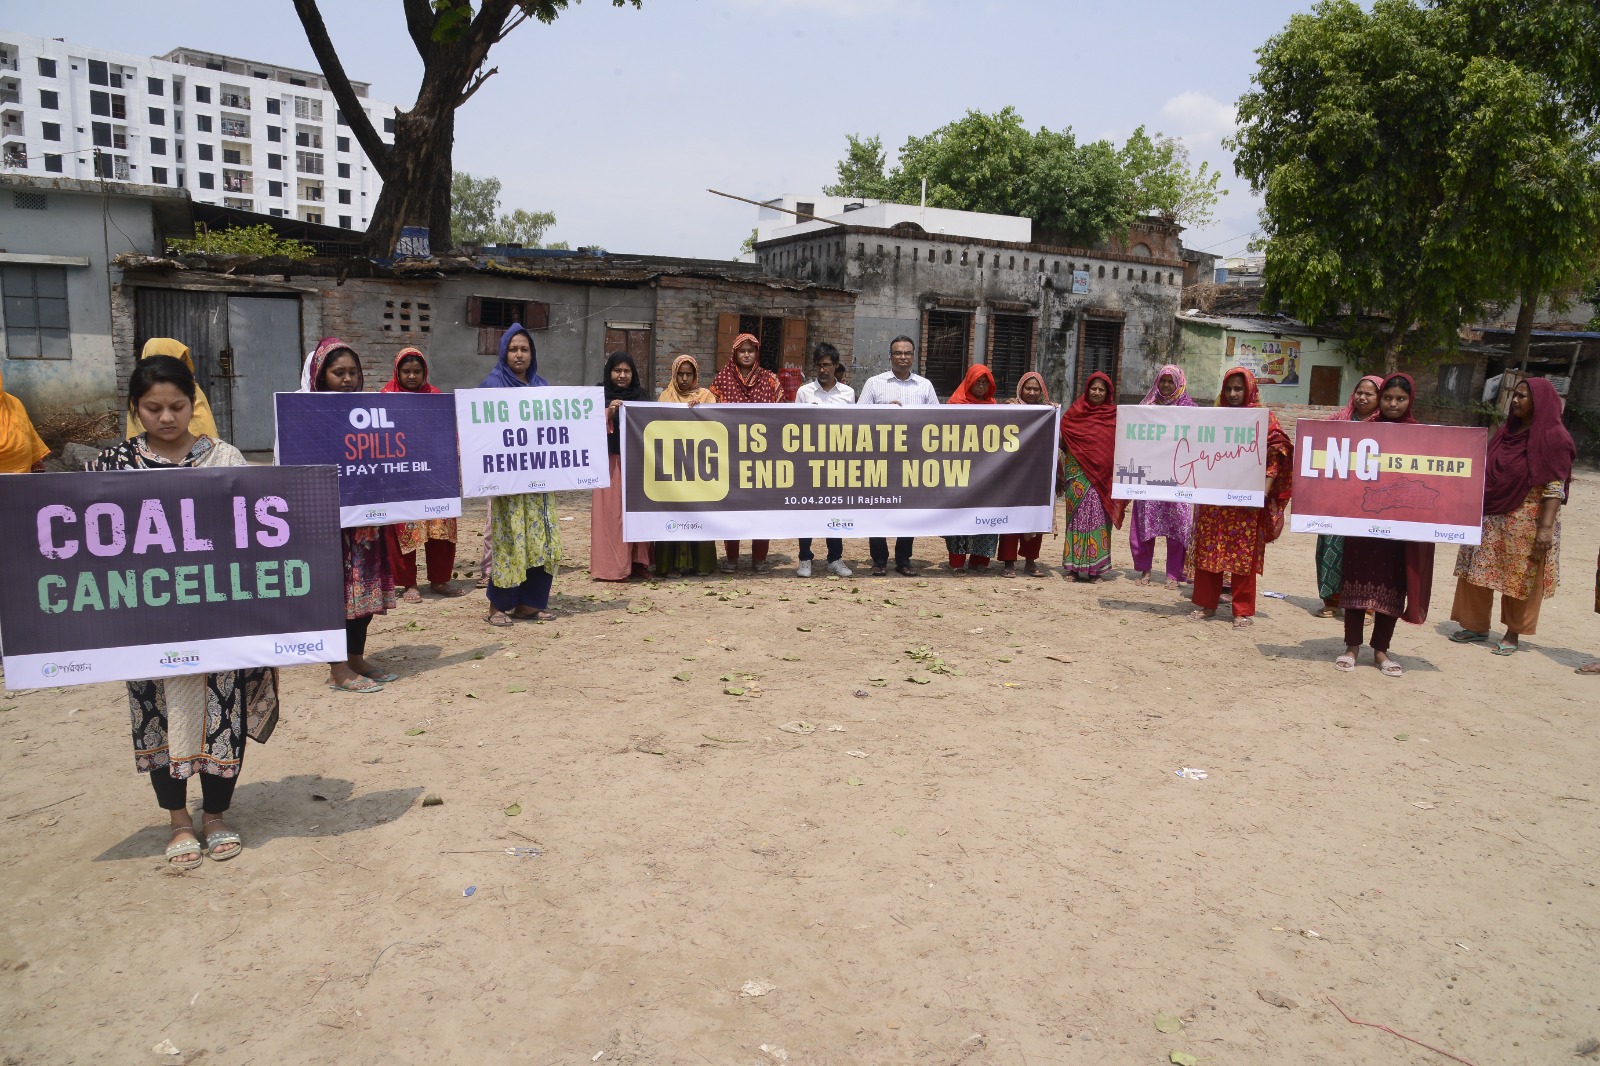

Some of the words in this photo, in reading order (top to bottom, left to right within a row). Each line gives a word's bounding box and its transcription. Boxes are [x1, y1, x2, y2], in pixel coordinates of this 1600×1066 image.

[348, 407, 395, 430] OIL
[471, 401, 510, 424] LNG
[519, 398, 594, 422] CRISIS?
[503, 428, 528, 448] GO
[537, 426, 570, 445] FOR
[738, 423, 768, 453] IS
[782, 424, 908, 453] CLIMATE
[921, 424, 1020, 453] CHAOS
[1126, 424, 1167, 442] KEEP
[1174, 425, 1190, 442] IT
[1198, 426, 1216, 443] IN
[1224, 426, 1256, 444] THE
[344, 432, 406, 462] SPILLS
[1174, 420, 1262, 488] Ground
[346, 464, 378, 476] PAY
[381, 462, 410, 474] THE
[412, 461, 432, 472] BIL
[482, 449, 590, 474] RENEWABLE
[654, 438, 719, 482] LNG
[1300, 436, 1381, 482] LNG
[1388, 458, 1403, 470] IS
[1410, 458, 1418, 470] A
[1426, 459, 1466, 473] TRAP
[578, 477, 599, 485] bwged
[738, 460, 794, 489] END
[808, 460, 888, 488] THEM
[902, 459, 971, 488] NOW
[784, 496, 844, 504] 10.04.2025
[858, 496, 902, 506] Rajshahi
[1228, 493, 1252, 502] bwged
[424, 504, 450, 514] bwged
[36, 498, 214, 560] COAL
[233, 495, 290, 548] IS
[976, 516, 1008, 526] bwged
[1434, 530, 1464, 540] bwged
[38, 559, 311, 614] CANCELLED
[274, 639, 324, 656] bwged
[160, 656, 200, 664] clean
